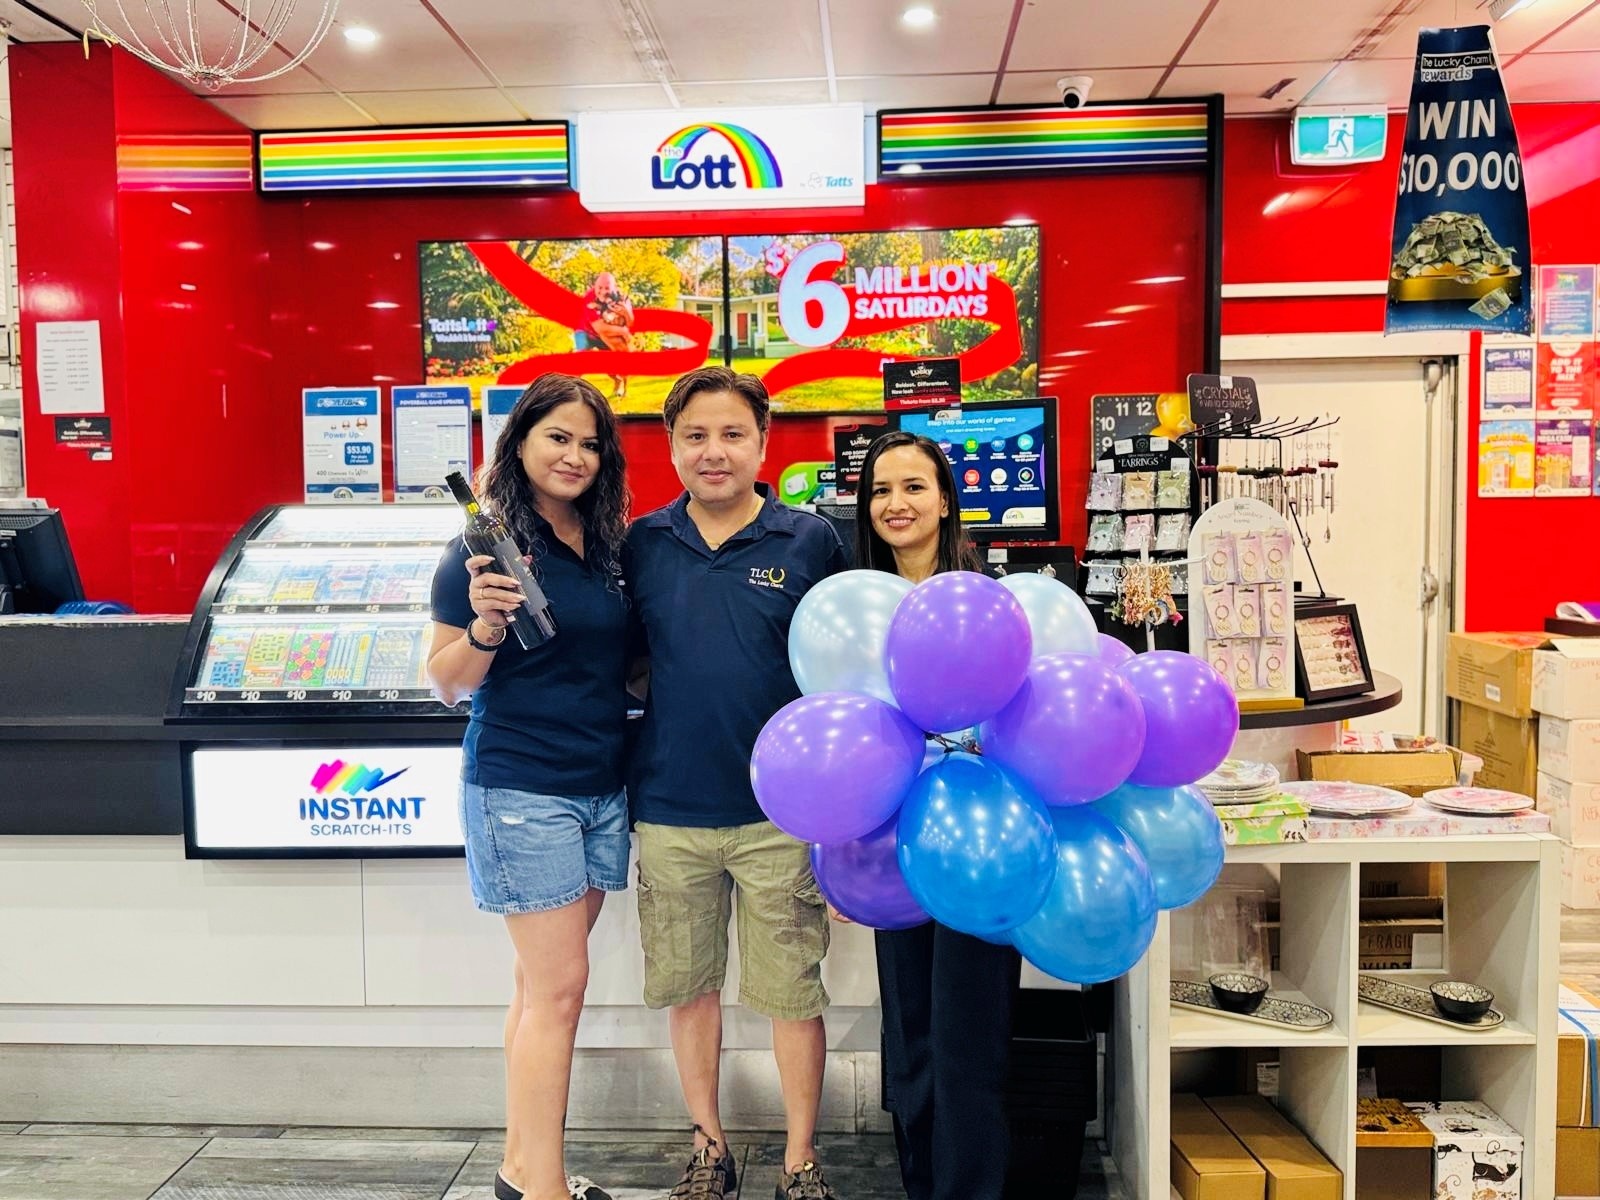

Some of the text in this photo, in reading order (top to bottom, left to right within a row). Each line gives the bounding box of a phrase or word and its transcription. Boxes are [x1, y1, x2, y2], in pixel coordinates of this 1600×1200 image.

[1434, 57, 1461, 68] Lucky
[1463, 55, 1489, 67] Charm
[1422, 66, 1472, 82] rewards
[1419, 99, 1496, 141] WIN
[663, 146, 682, 157] the
[651, 154, 737, 189] Lott
[824, 176, 854, 188] Tatts
[854, 295, 988, 320] SATURDAYS
[1116, 402, 1129, 416] 11
[1136, 401, 1152, 416] 12
[1099, 416, 1116, 431] 10
[323, 431, 360, 440] Power Up
[346, 445, 372, 455] $53.90
[1296, 441, 1314, 450] Use
[1121, 457, 1159, 468] EARRINGS
[750, 567, 769, 579] TLC
[222, 605, 236, 614] $5
[264, 605, 278, 614] $5
[315, 605, 329, 614] $5
[366, 604, 380, 613] $5
[409, 604, 423, 612] $5
[197, 691, 216, 701] $10
[241, 691, 260, 701] $10
[287, 690, 307, 701] $10
[332, 690, 352, 700] $10
[379, 690, 399, 700] $10
[299, 797, 426, 820] INSTANT
[310, 823, 412, 836] SCRATCH-ITS
